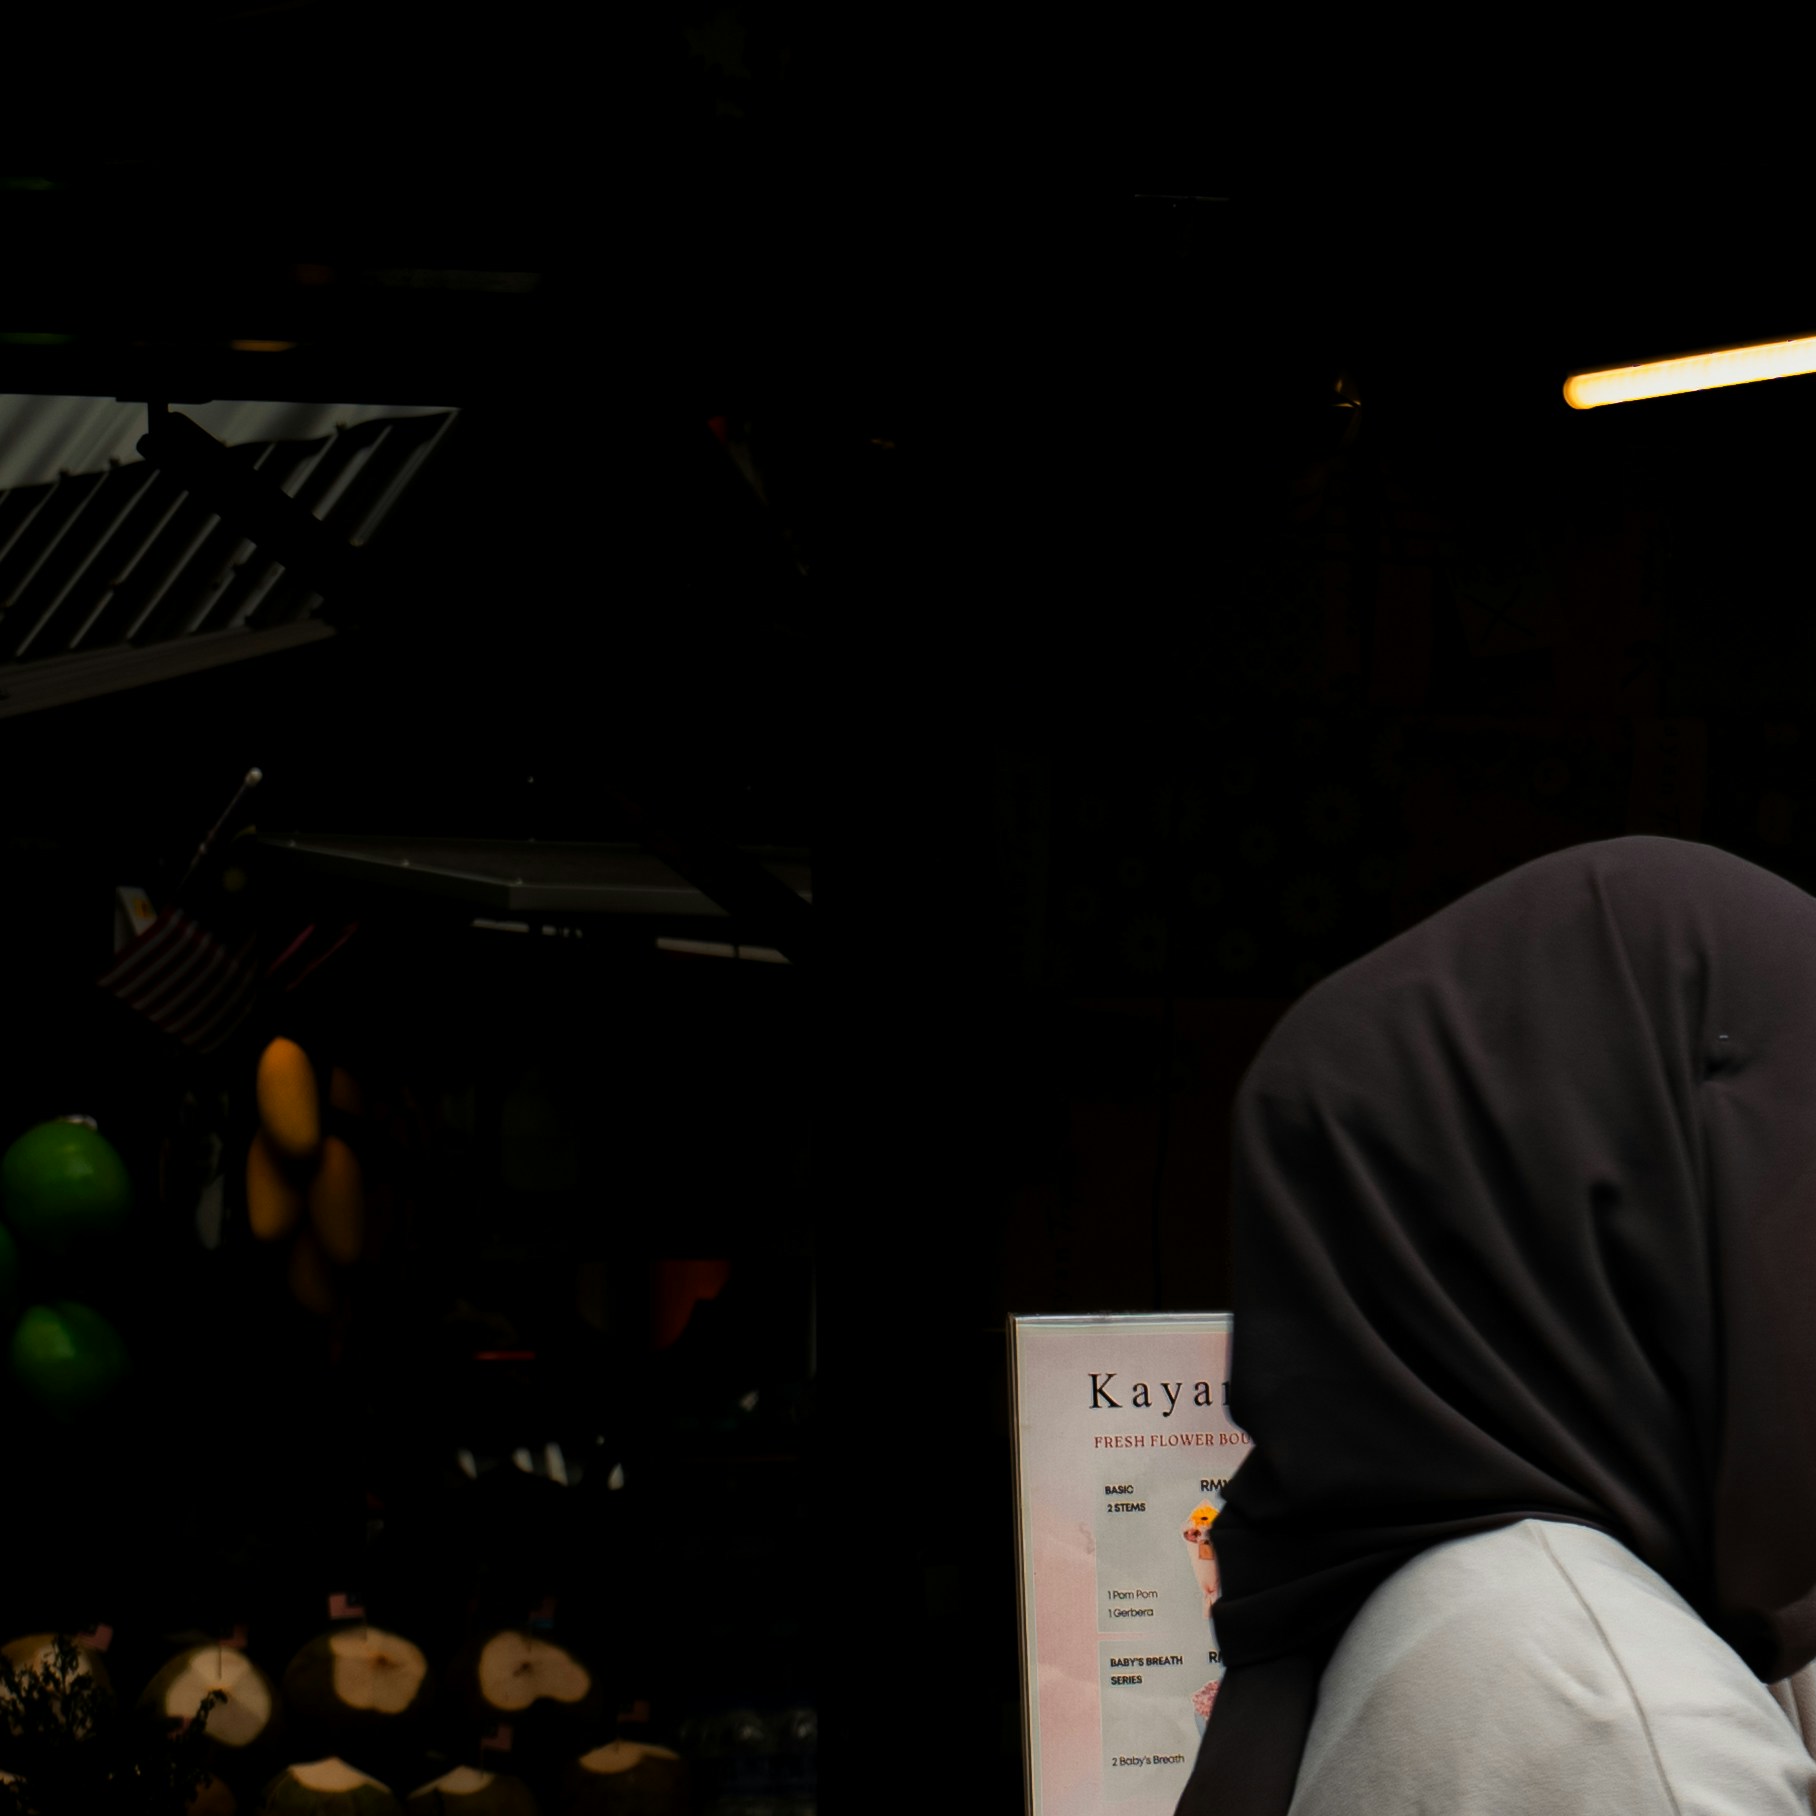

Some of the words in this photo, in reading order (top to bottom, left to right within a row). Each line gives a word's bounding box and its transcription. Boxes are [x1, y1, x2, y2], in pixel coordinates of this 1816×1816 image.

[1094, 1435, 1145, 1448] FRESH
[1150, 1433, 1214, 1447] FLOWER
[1104, 1484, 1134, 1495] BASIC
[1107, 1504, 1113, 1512] 2
[1114, 1502, 1147, 1512] STEMS
[1112, 1590, 1135, 1600] Pom
[1136, 1589, 1158, 1599] Pom
[1113, 1608, 1154, 1618] Gerbera
[1110, 1657, 1145, 1667] BABY'S
[1146, 1655, 1183, 1666] BREATH
[1110, 1675, 1142, 1685] SERIES
[1119, 1755, 1151, 1767] Baby's
[1153, 1754, 1185, 1764] Breath
